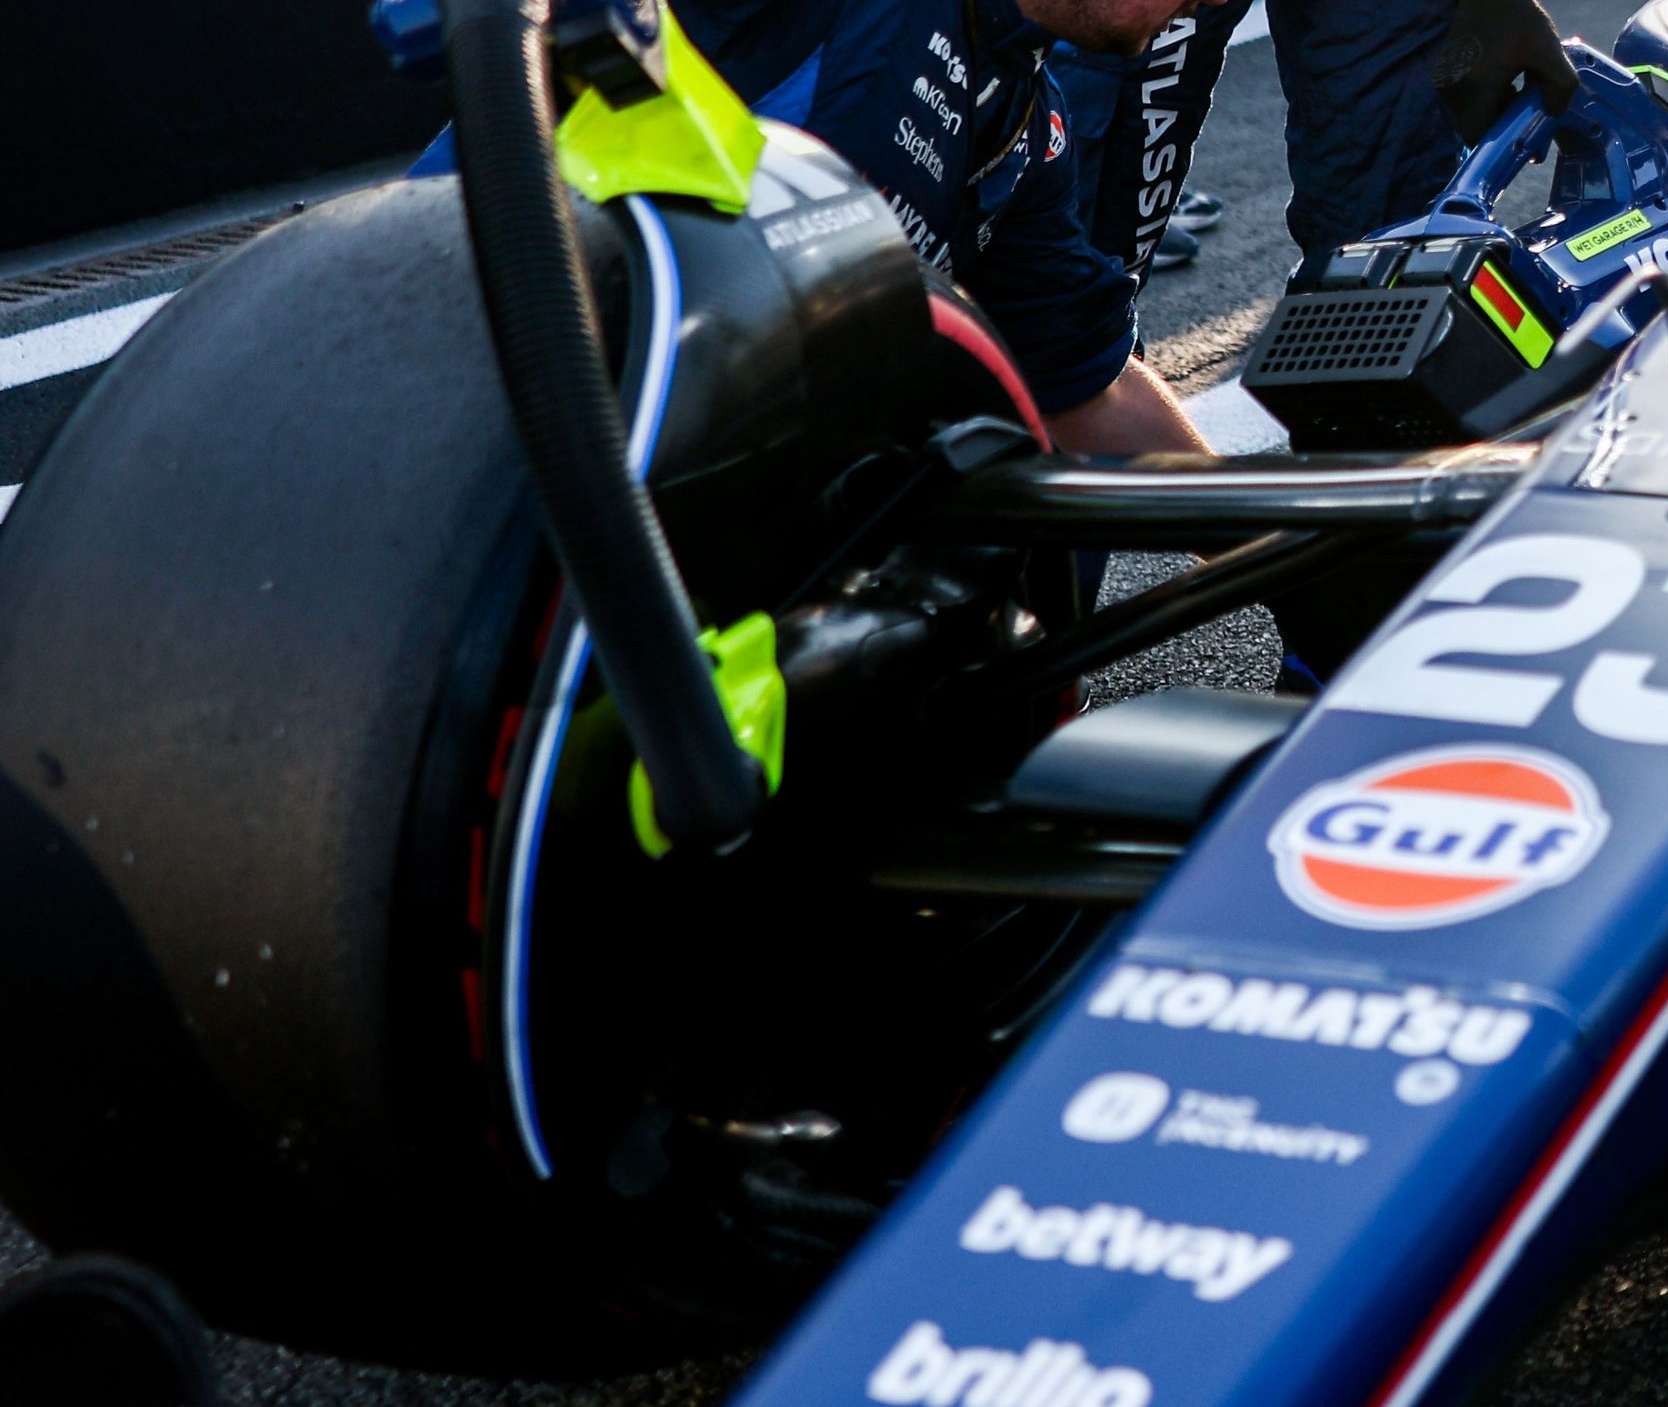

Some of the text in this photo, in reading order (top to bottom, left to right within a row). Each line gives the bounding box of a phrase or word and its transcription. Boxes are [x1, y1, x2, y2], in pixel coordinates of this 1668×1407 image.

[895, 116, 944, 182] Stephens
[1124, 17, 1196, 273] ATLASSIA
[1574, 238, 1594, 253] WET
[1593, 224, 1628, 244] GARAGE
[1305, 800, 1578, 866] Gulf
[1088, 963, 1532, 1066] KOMATSU
[959, 1184, 1293, 1302] betway
